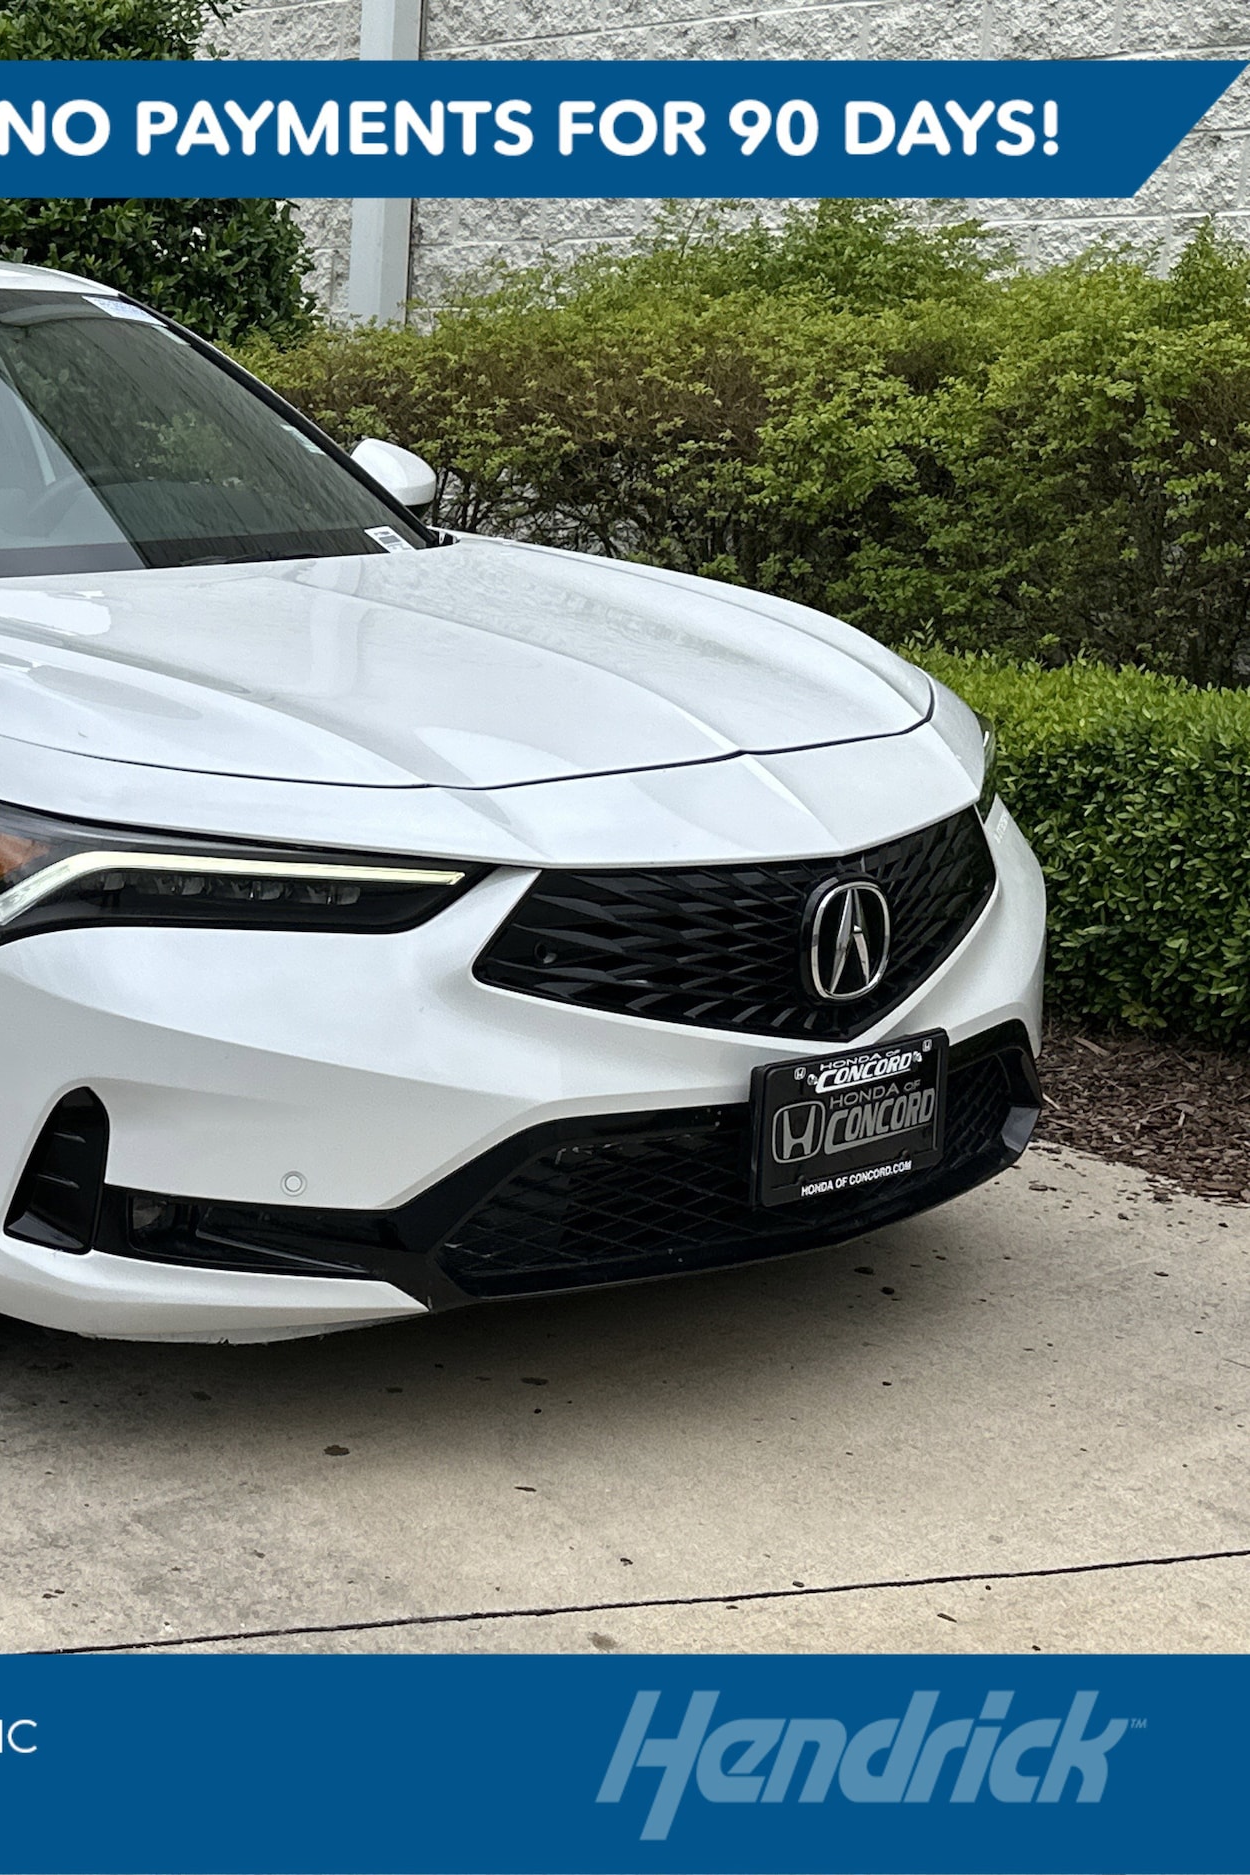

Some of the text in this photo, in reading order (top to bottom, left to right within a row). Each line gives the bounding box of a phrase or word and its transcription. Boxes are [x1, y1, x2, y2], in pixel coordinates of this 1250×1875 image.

[815, 1052, 912, 1094] CONCORD
[820, 1049, 901, 1071] HONDA OF
[830, 1079, 921, 1110] HONDA OF
[824, 1087, 935, 1155] CONCORD
[801, 1160, 912, 1197] HONDA OF CONCORD.COM
